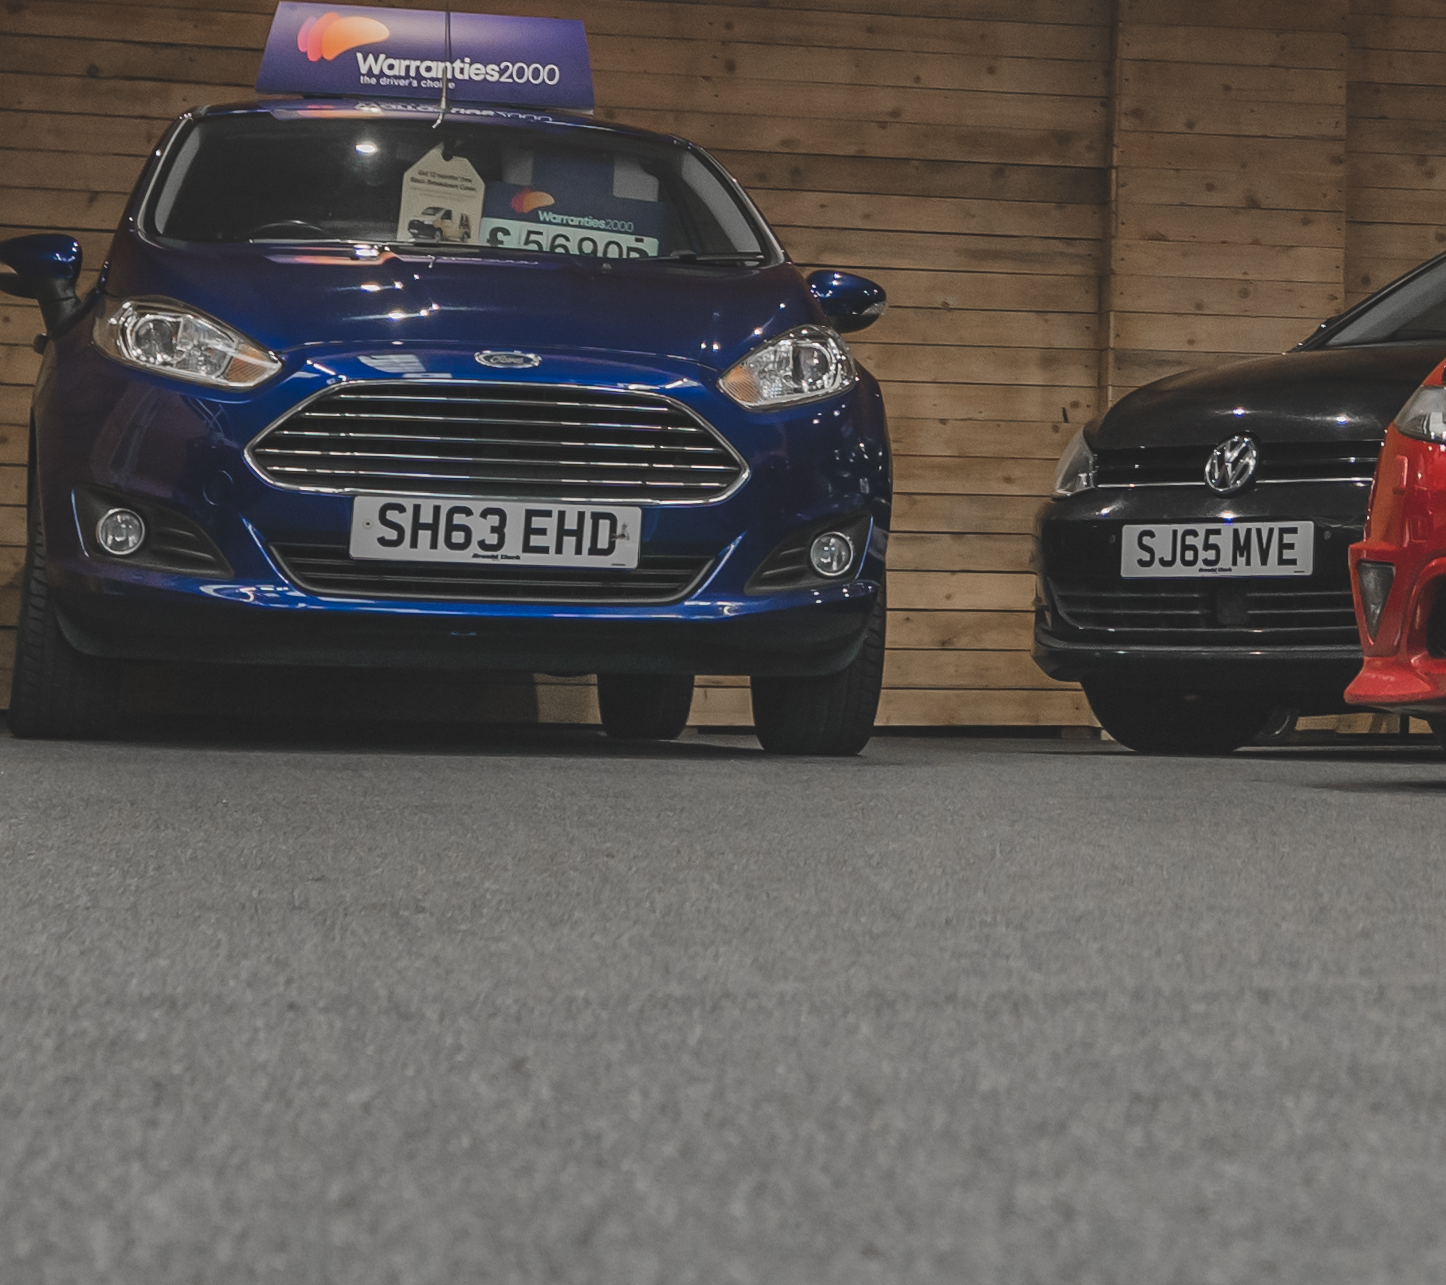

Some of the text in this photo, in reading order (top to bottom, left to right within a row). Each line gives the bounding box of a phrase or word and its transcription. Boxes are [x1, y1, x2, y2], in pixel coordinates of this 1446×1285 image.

[356, 52, 560, 85] Warranties2000
[360, 75, 456, 89] the driver's choie
[538, 210, 634, 232] Warranties2000
[376, 502, 618, 556] SH63 EHD
[1136, 527, 1299, 568] SJ65 MVE
